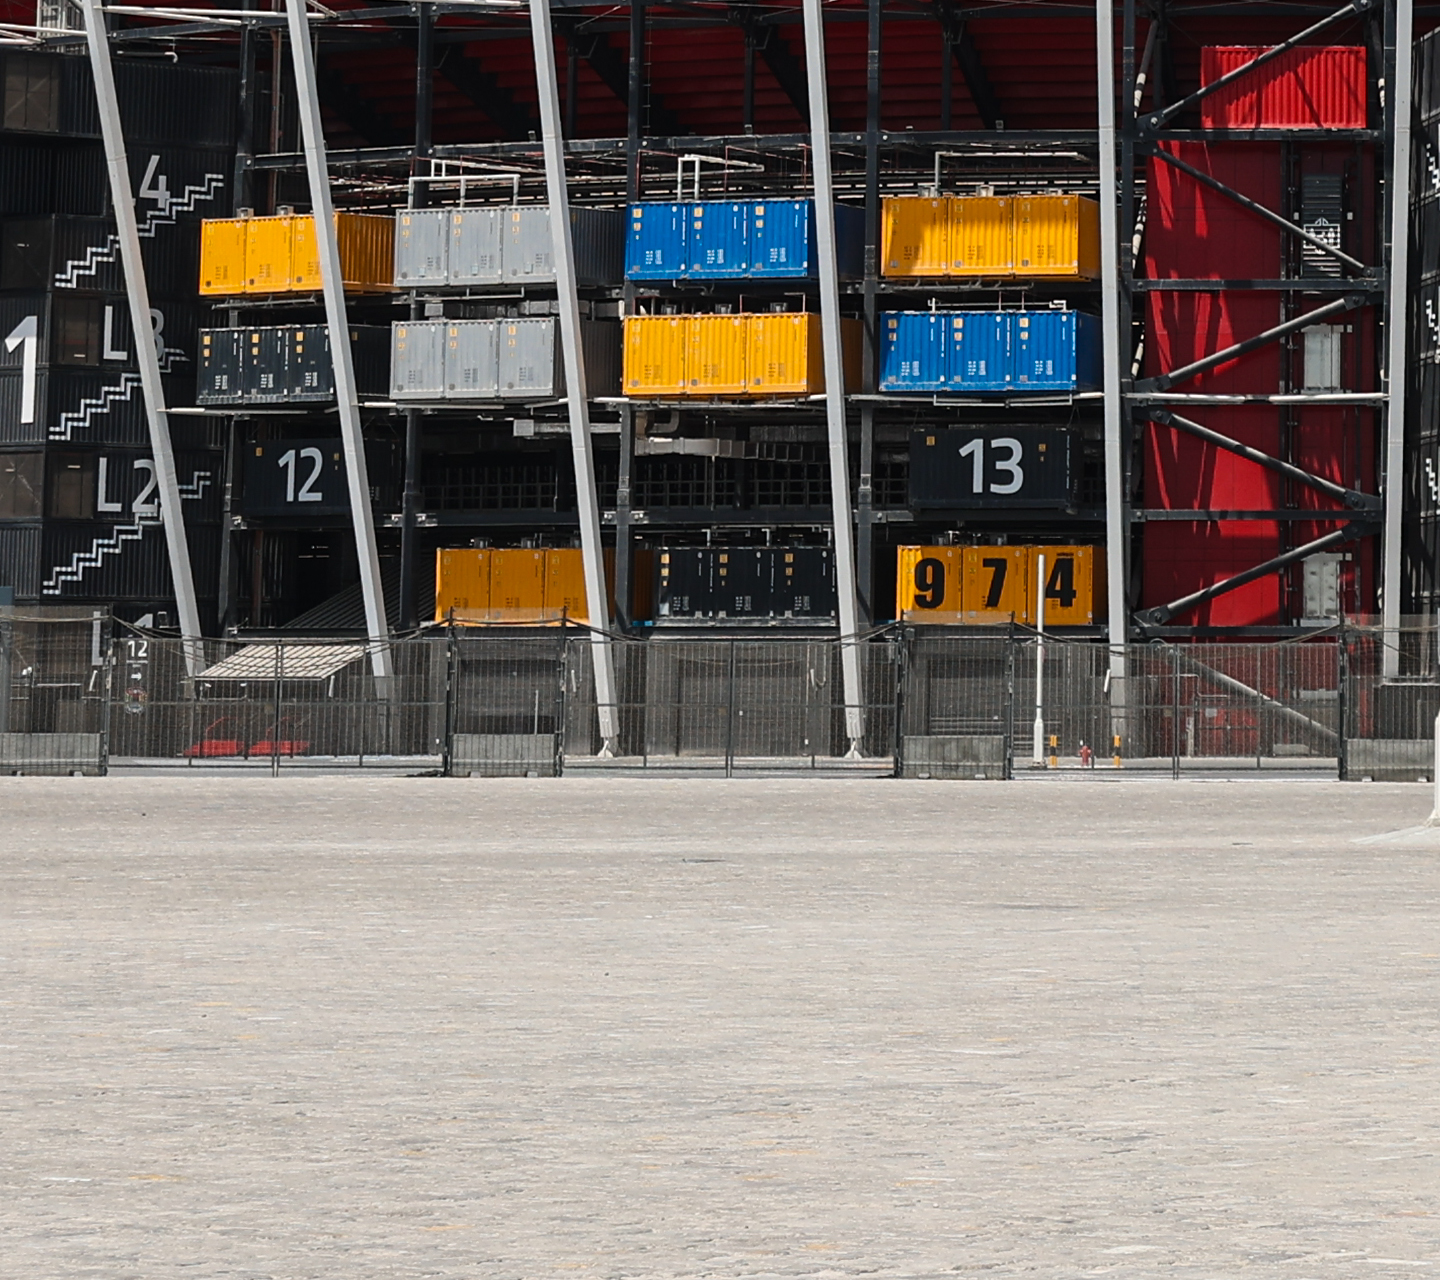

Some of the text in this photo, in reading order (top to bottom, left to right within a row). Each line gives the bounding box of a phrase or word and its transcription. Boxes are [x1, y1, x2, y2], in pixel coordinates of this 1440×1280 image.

[97, 457, 159, 513] L2
[277, 446, 324, 502] 12
[958, 436, 1024, 495] 13
[127, 639, 148, 658] 12
